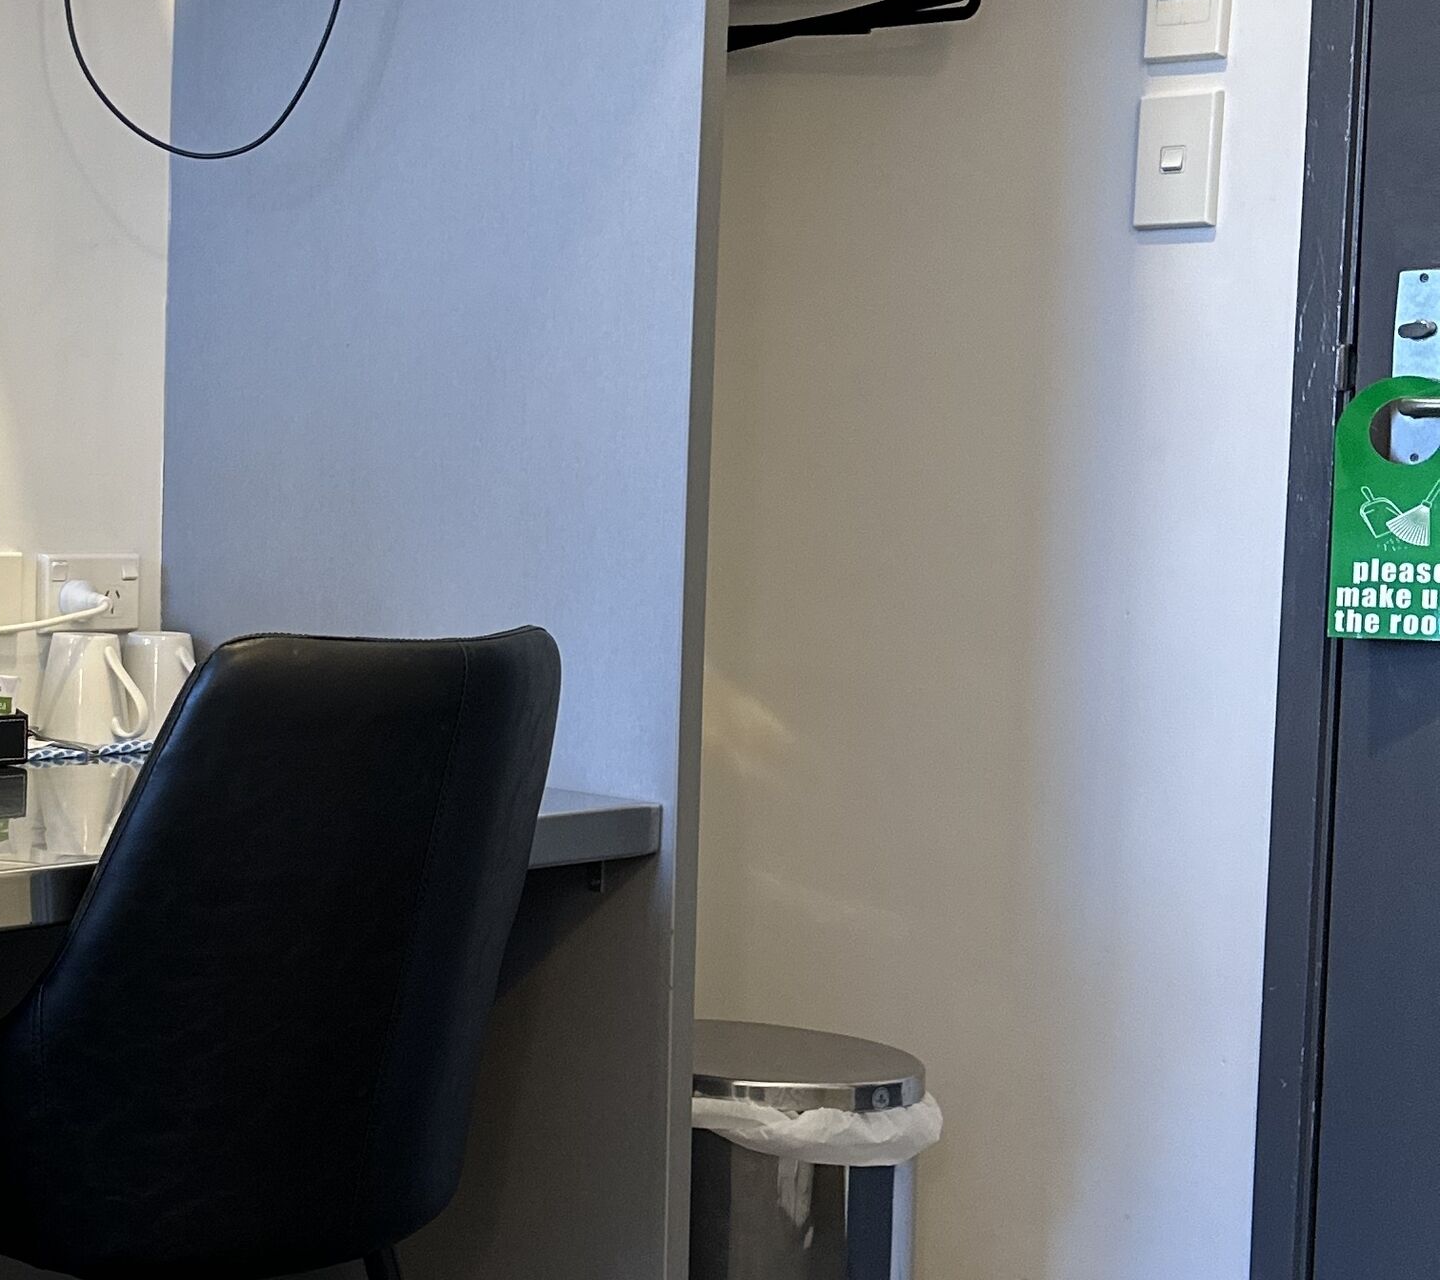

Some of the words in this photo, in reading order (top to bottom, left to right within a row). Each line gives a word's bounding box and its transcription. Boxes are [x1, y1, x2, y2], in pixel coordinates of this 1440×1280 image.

[1336, 584, 1412, 609] make
[1421, 589, 1439, 610] u
[1334, 609, 1380, 634] the
[1389, 614, 1440, 635] roo
